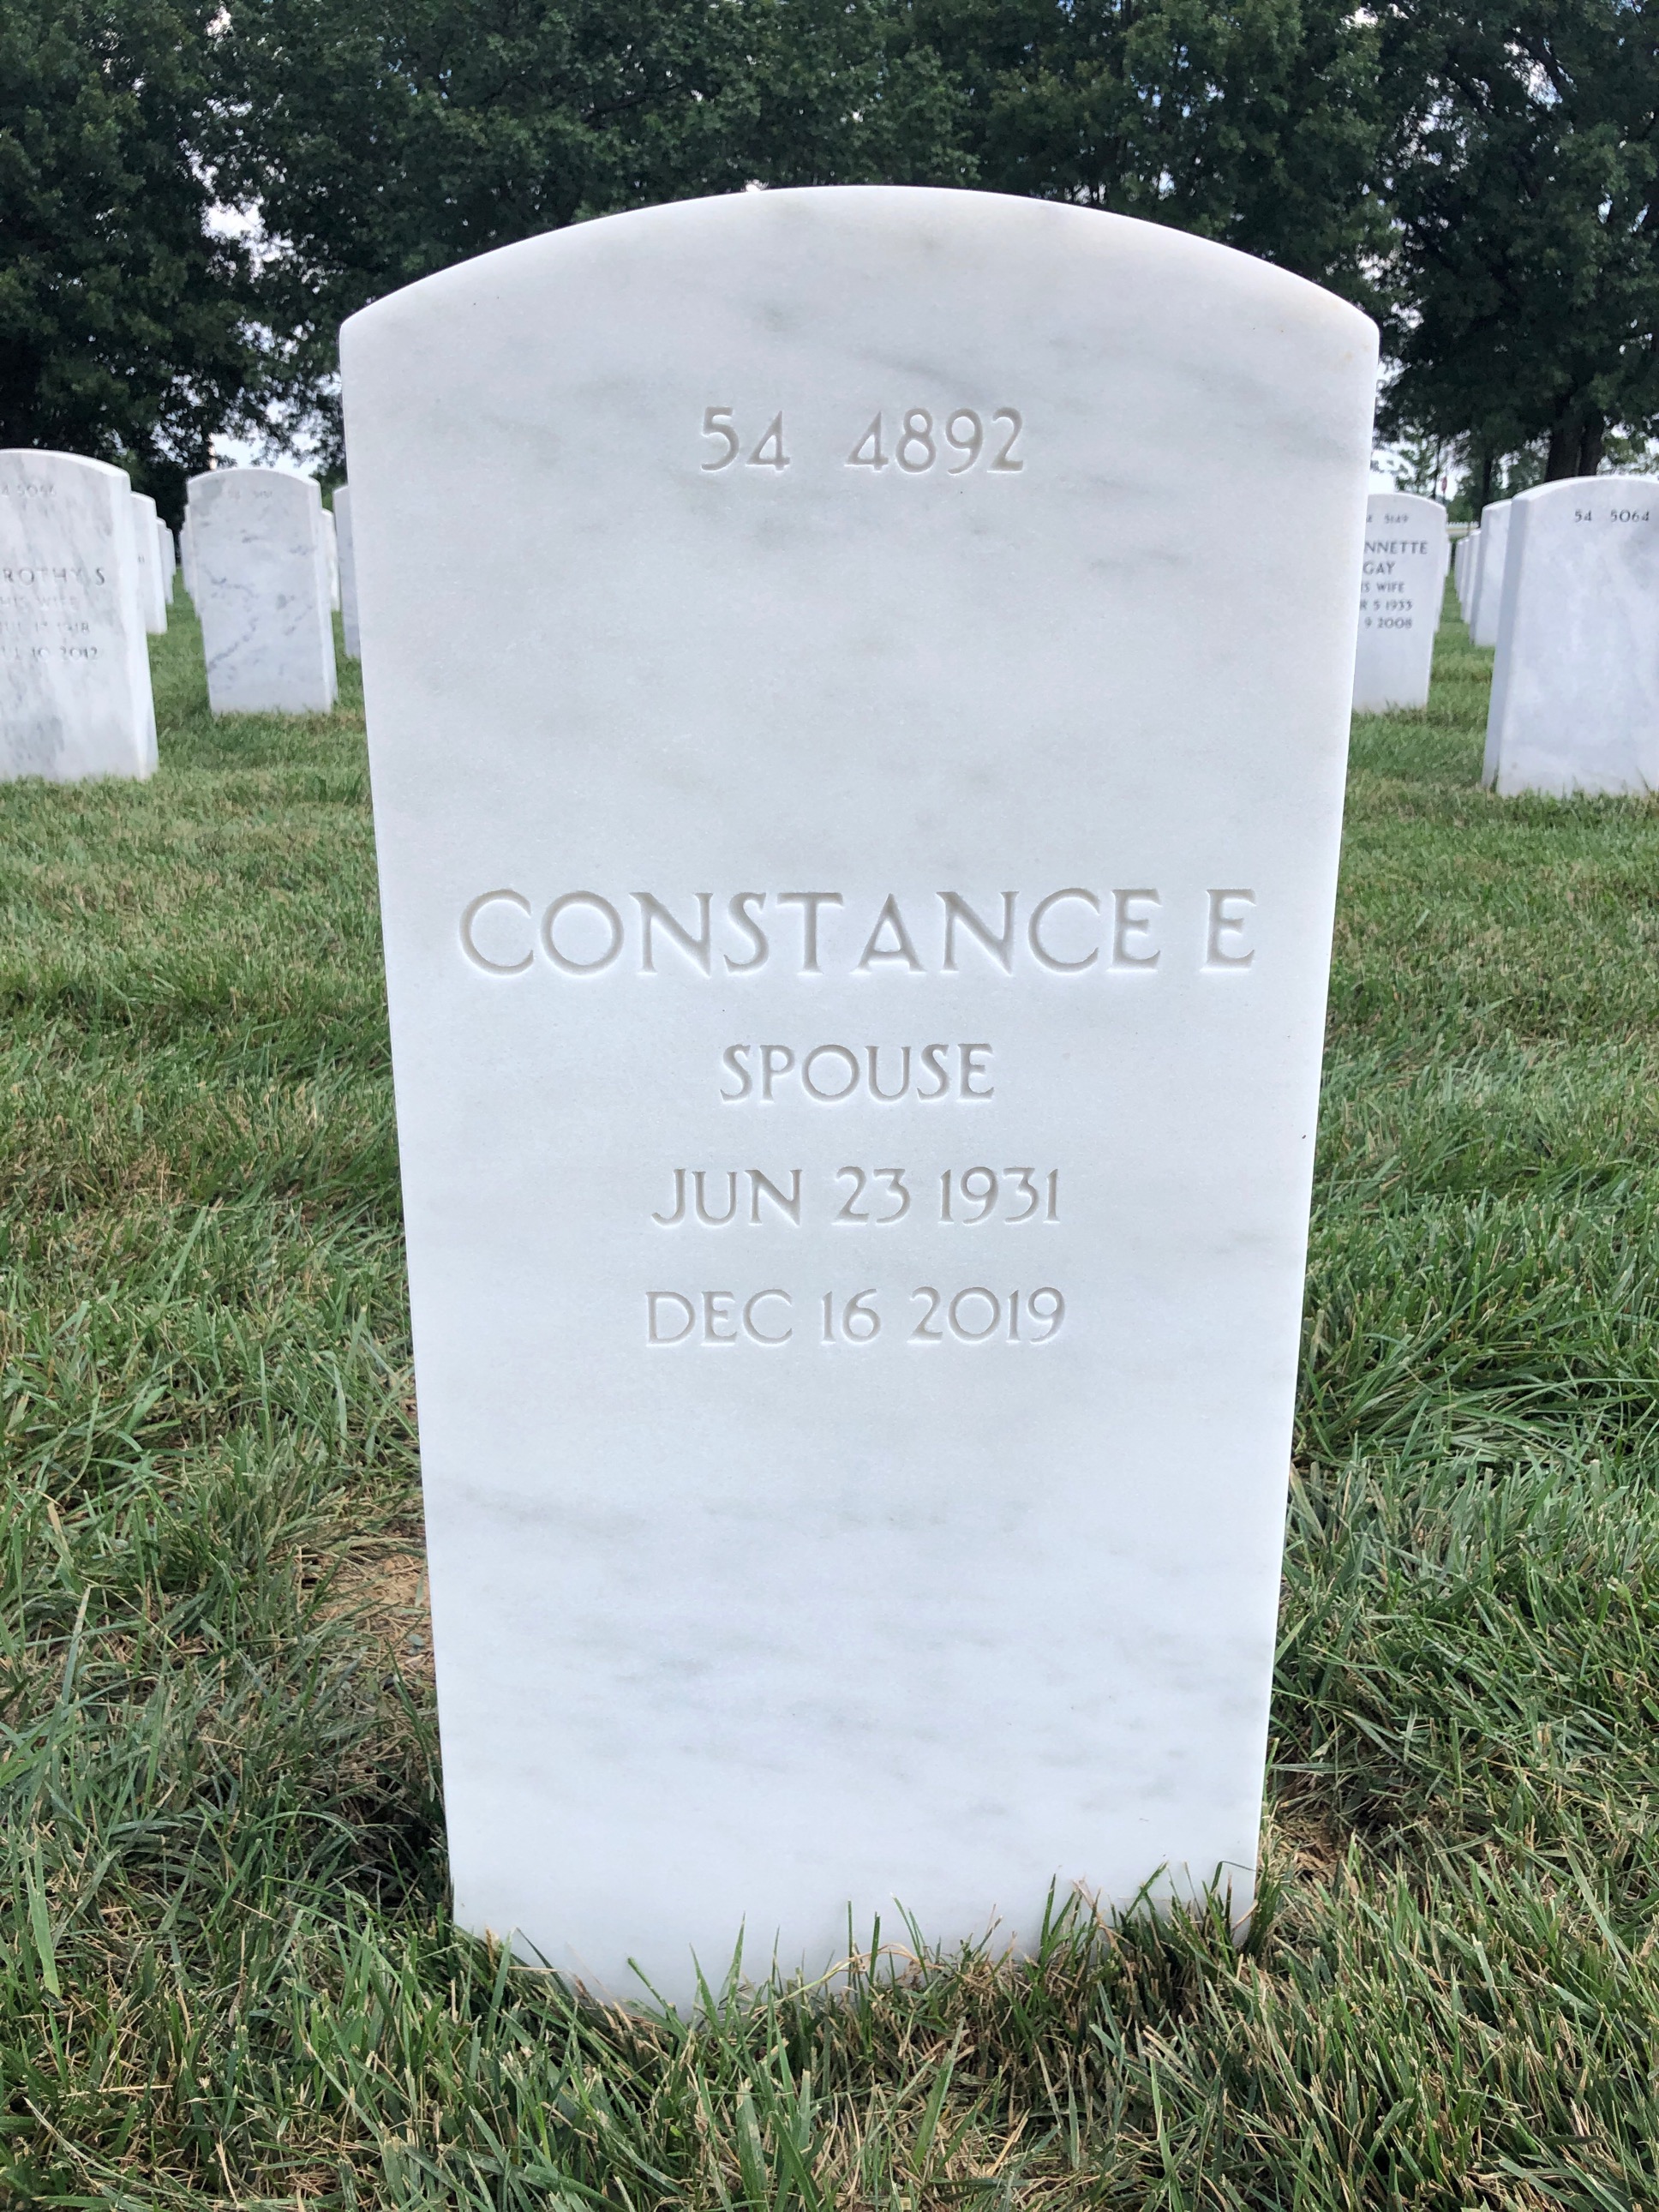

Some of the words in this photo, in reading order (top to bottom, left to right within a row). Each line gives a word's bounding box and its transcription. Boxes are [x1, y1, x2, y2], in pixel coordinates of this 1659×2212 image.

[701, 406, 790, 471] 54
[844, 407, 1024, 475] 4892
[1574, 508, 1592, 523] 54
[1610, 508, 1650, 523] 5064
[95, 566, 105, 586] S
[1363, 560, 1396, 575] GAY
[1376, 581, 1405, 593] WIFE
[1377, 617, 1413, 629] 2008
[59, 645, 99, 662] 2012
[459, 887, 1159, 978] CONSTANCE
[1201, 887, 1258, 973] E
[720, 1042, 996, 1104] SPOUSE
[650, 1166, 804, 1227] JUN
[832, 1166, 911, 1226] 23
[938, 1166, 1061, 1226] 1931
[645, 1288, 794, 1346] DEC
[819, 1288, 882, 1346] 16
[907, 1286, 1067, 1346] 2019
